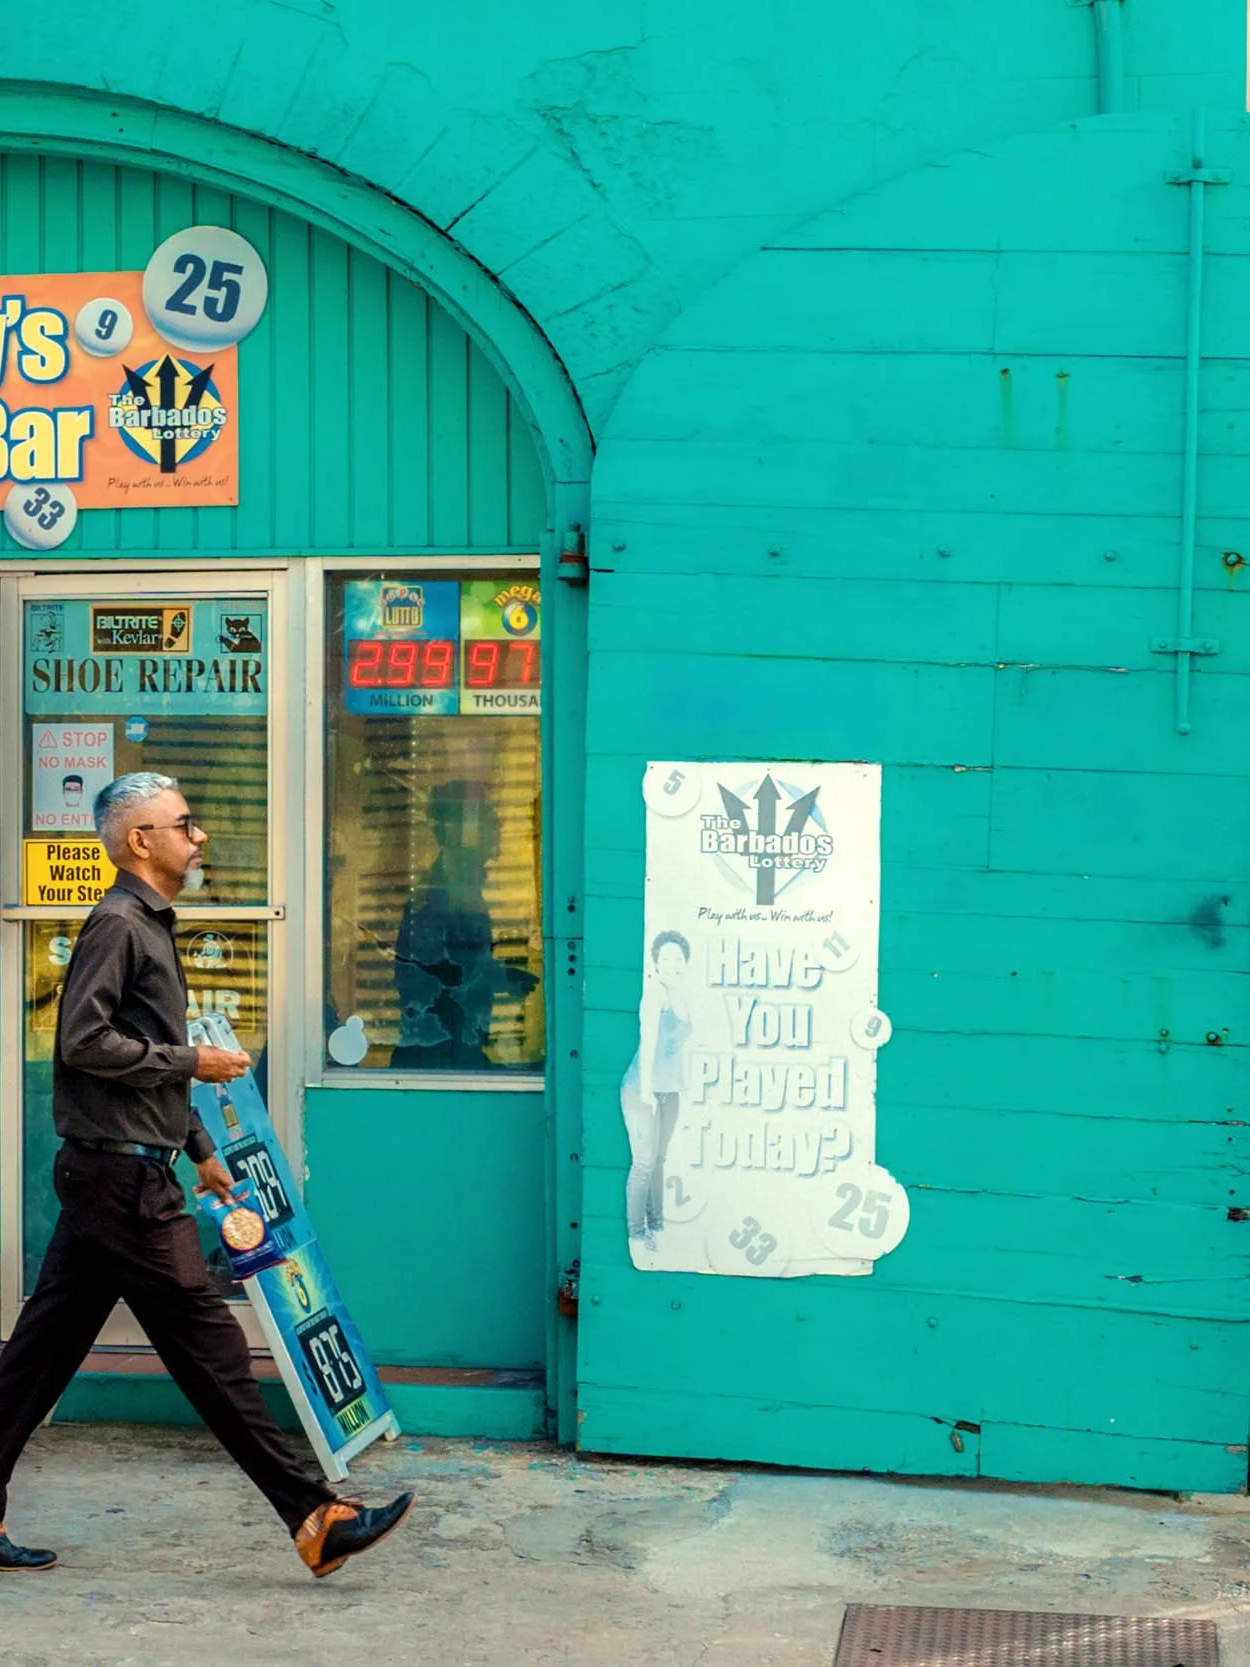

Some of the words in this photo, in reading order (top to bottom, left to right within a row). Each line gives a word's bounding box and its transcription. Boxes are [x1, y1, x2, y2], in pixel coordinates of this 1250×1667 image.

[164, 253, 243, 322] 25
[94, 310, 118, 339] 9
[108, 393, 145, 406] The
[109, 405, 227, 427] Barbados
[151, 427, 222, 440] Lottery
[108, 477, 130, 493] Play
[173, 477, 192, 488] Win
[23, 487, 65, 531] 33
[96, 615, 159, 630] BILTRITE
[510, 603, 529, 630] 6
[112, 629, 160, 645] Kevlar
[32, 658, 124, 693] SHOE
[139, 658, 263, 693] REPAIR
[62, 732, 108, 748] STOP
[38, 756, 60, 769] NO
[64, 756, 107, 769] MASK
[663, 770, 685, 796] 5
[35, 813, 57, 826] NO
[700, 814, 742, 829] The
[47, 844, 101, 861] Please
[701, 829, 834, 855] Barbados
[49, 864, 101, 881] Watch
[748, 854, 828, 873] Lottery
[38, 885, 74, 902] Your
[698, 906, 724, 926] Play
[725, 908, 746, 921] with
[770, 909, 791, 921] Win
[792, 909, 815, 922] with
[822, 932, 850, 958] 11
[707, 936, 824, 990] Have
[726, 994, 812, 1048] You
[864, 1015, 883, 1038] 9
[692, 1053, 847, 1112] Played
[686, 1121, 853, 1177] Today?
[666, 1175, 692, 1207] 2
[828, 1182, 893, 1240] 25
[728, 1216, 778, 1266] 33
